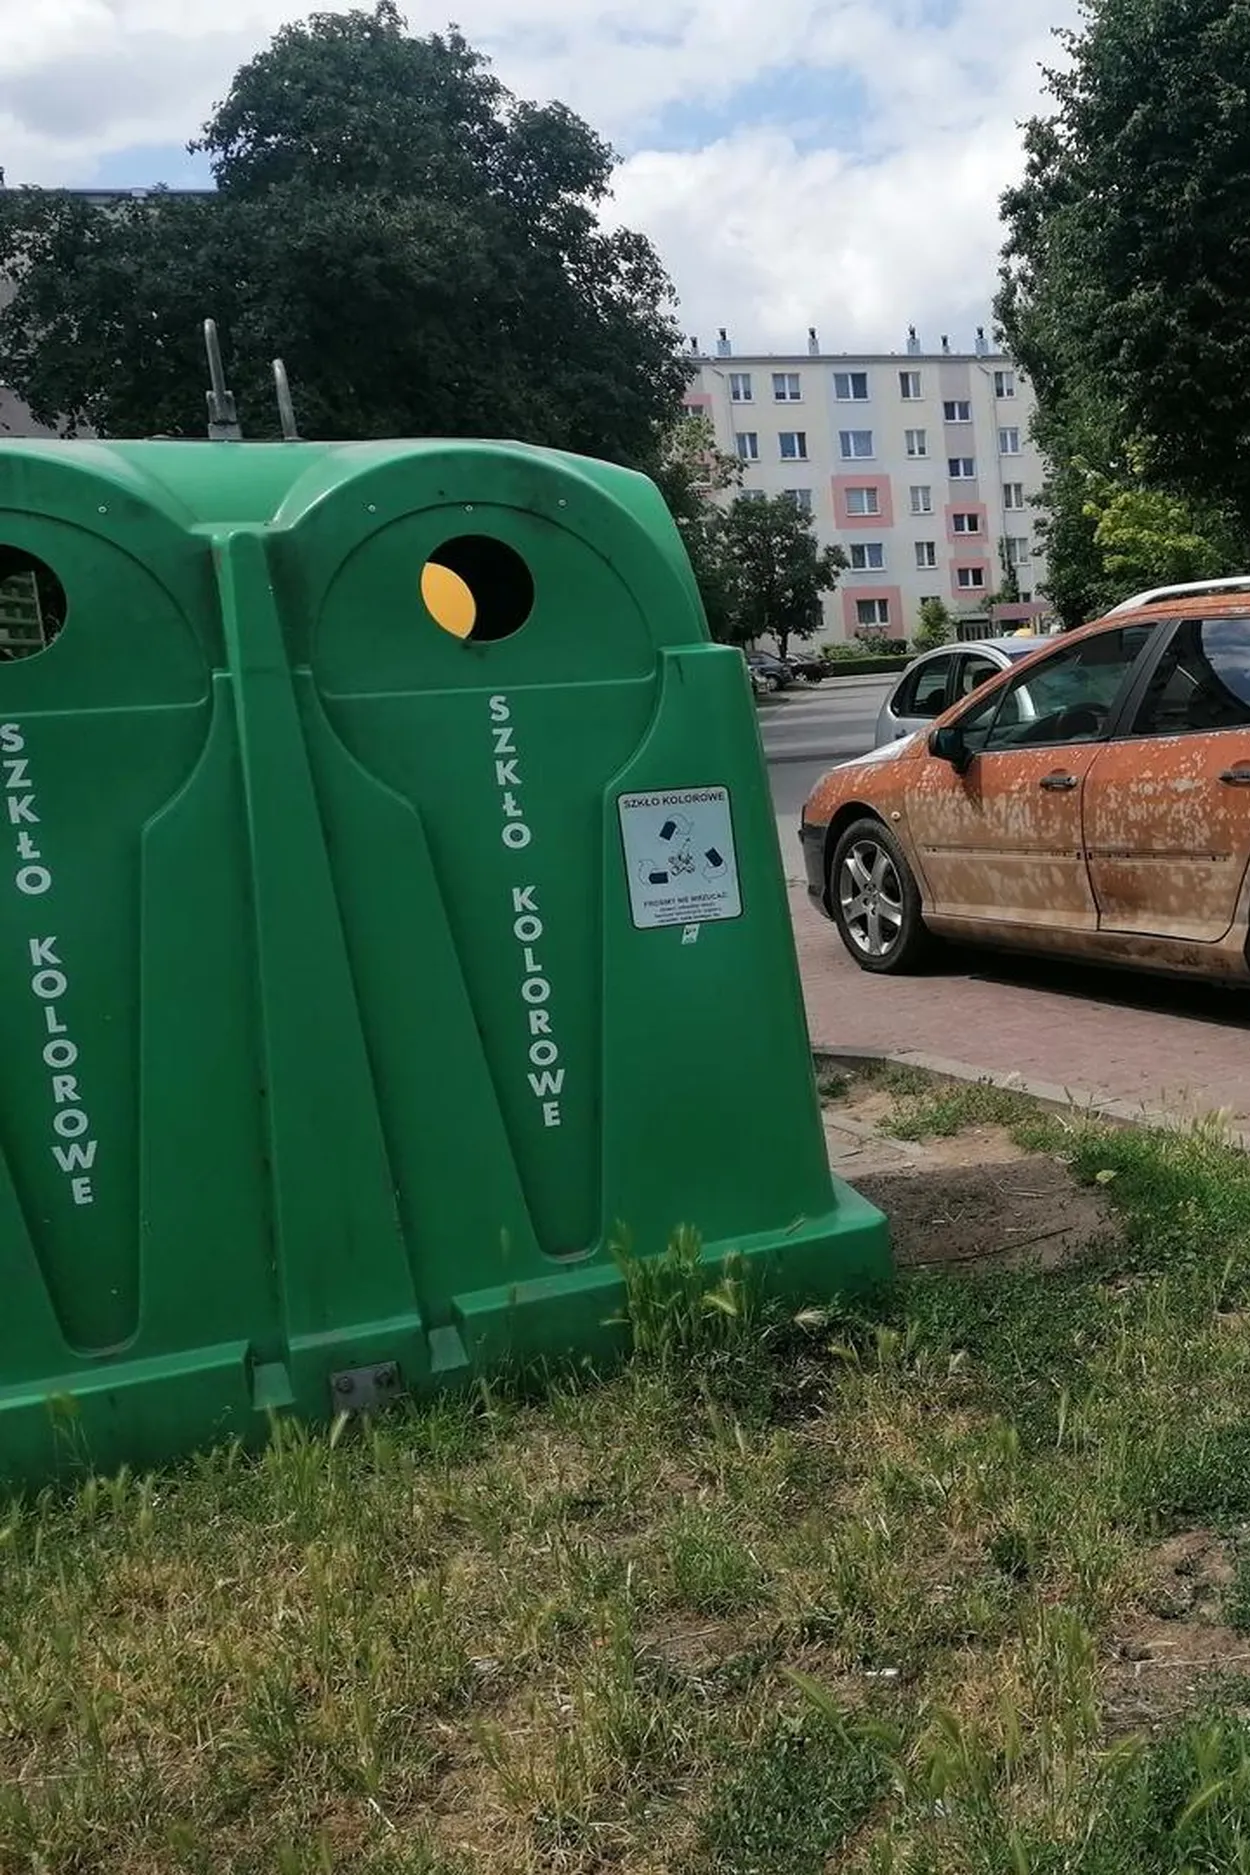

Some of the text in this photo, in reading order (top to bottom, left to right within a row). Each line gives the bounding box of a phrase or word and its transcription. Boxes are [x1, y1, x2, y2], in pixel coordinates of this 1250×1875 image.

[0, 723, 98, 1206] SZKŁO KOLOROWE
[489, 695, 566, 1128] SZKŁO KOLOROWE
[662, 791, 725, 806] KOLOROWE
